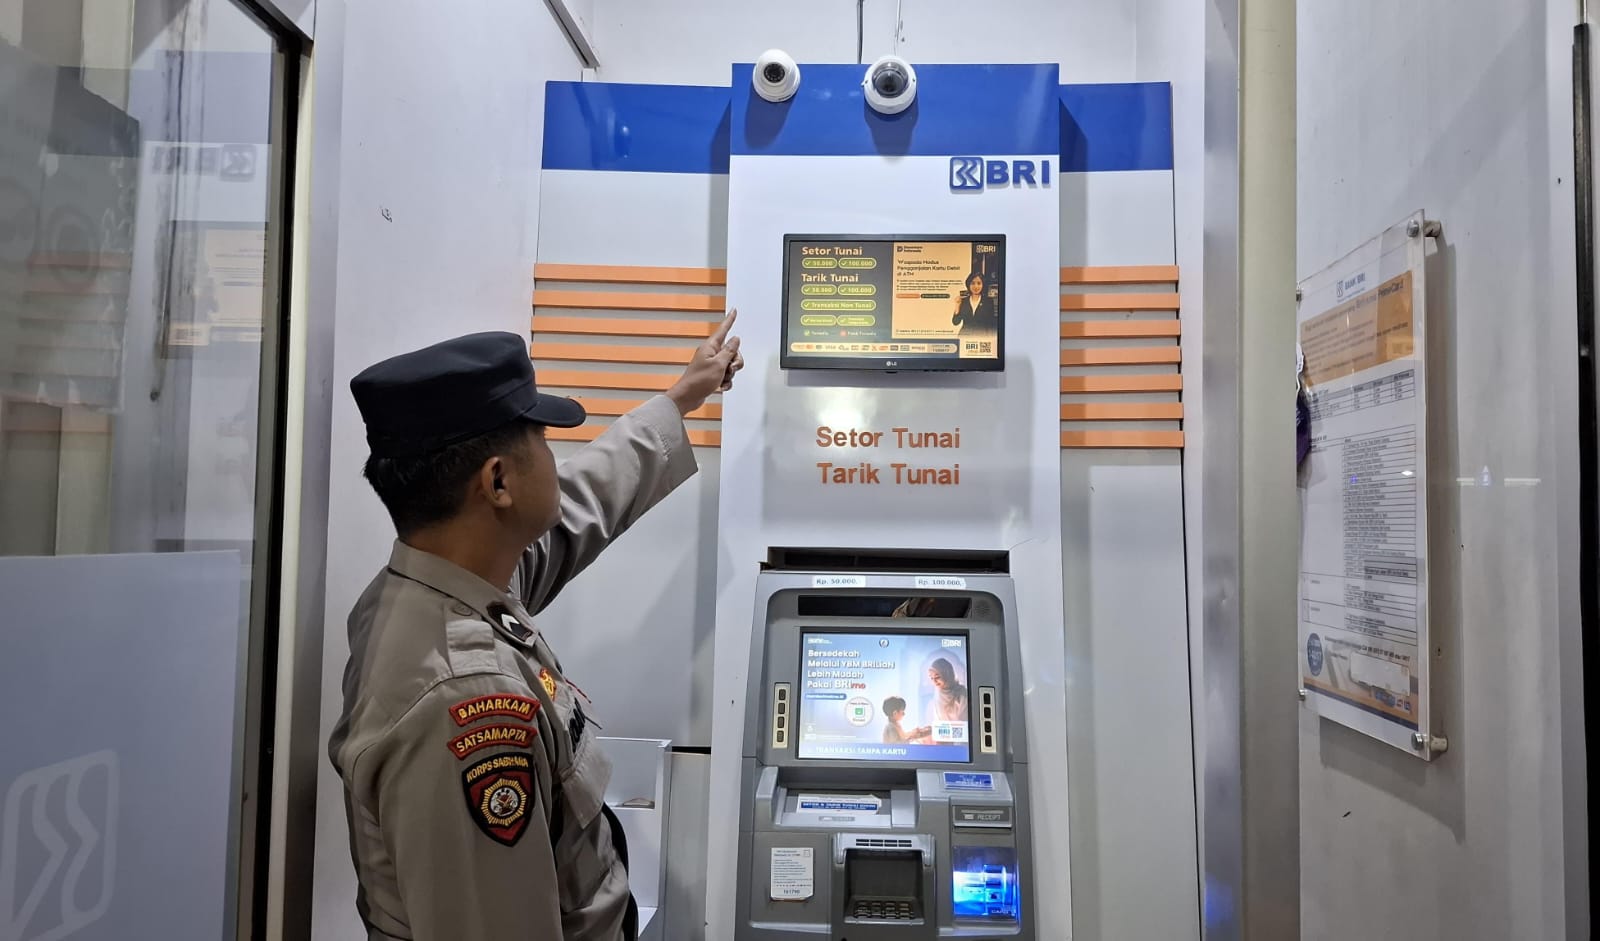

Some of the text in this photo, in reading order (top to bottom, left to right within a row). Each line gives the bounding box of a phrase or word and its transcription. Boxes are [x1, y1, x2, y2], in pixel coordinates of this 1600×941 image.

[986, 160, 1050, 186] BRI
[802, 246, 863, 256] Setor Tunai
[983, 245, 997, 253] BRI
[801, 273, 859, 283] Tarik Tunai
[815, 426, 960, 449] Setor Tunai
[816, 462, 960, 485] Tarik Tunai
[807, 649, 860, 658] Bersedekah
[807, 660, 840, 668] Melalui
[841, 660, 862, 670] YBM
[807, 670, 864, 679] Lebih Mudah
[807, 680, 832, 689] Pakai
[458, 698, 531, 719] BAHARKAM
[456, 727, 527, 752] SATSAMAPTA
[881, 747, 907, 756] KARTU
[466, 761, 493, 783] KORPS
